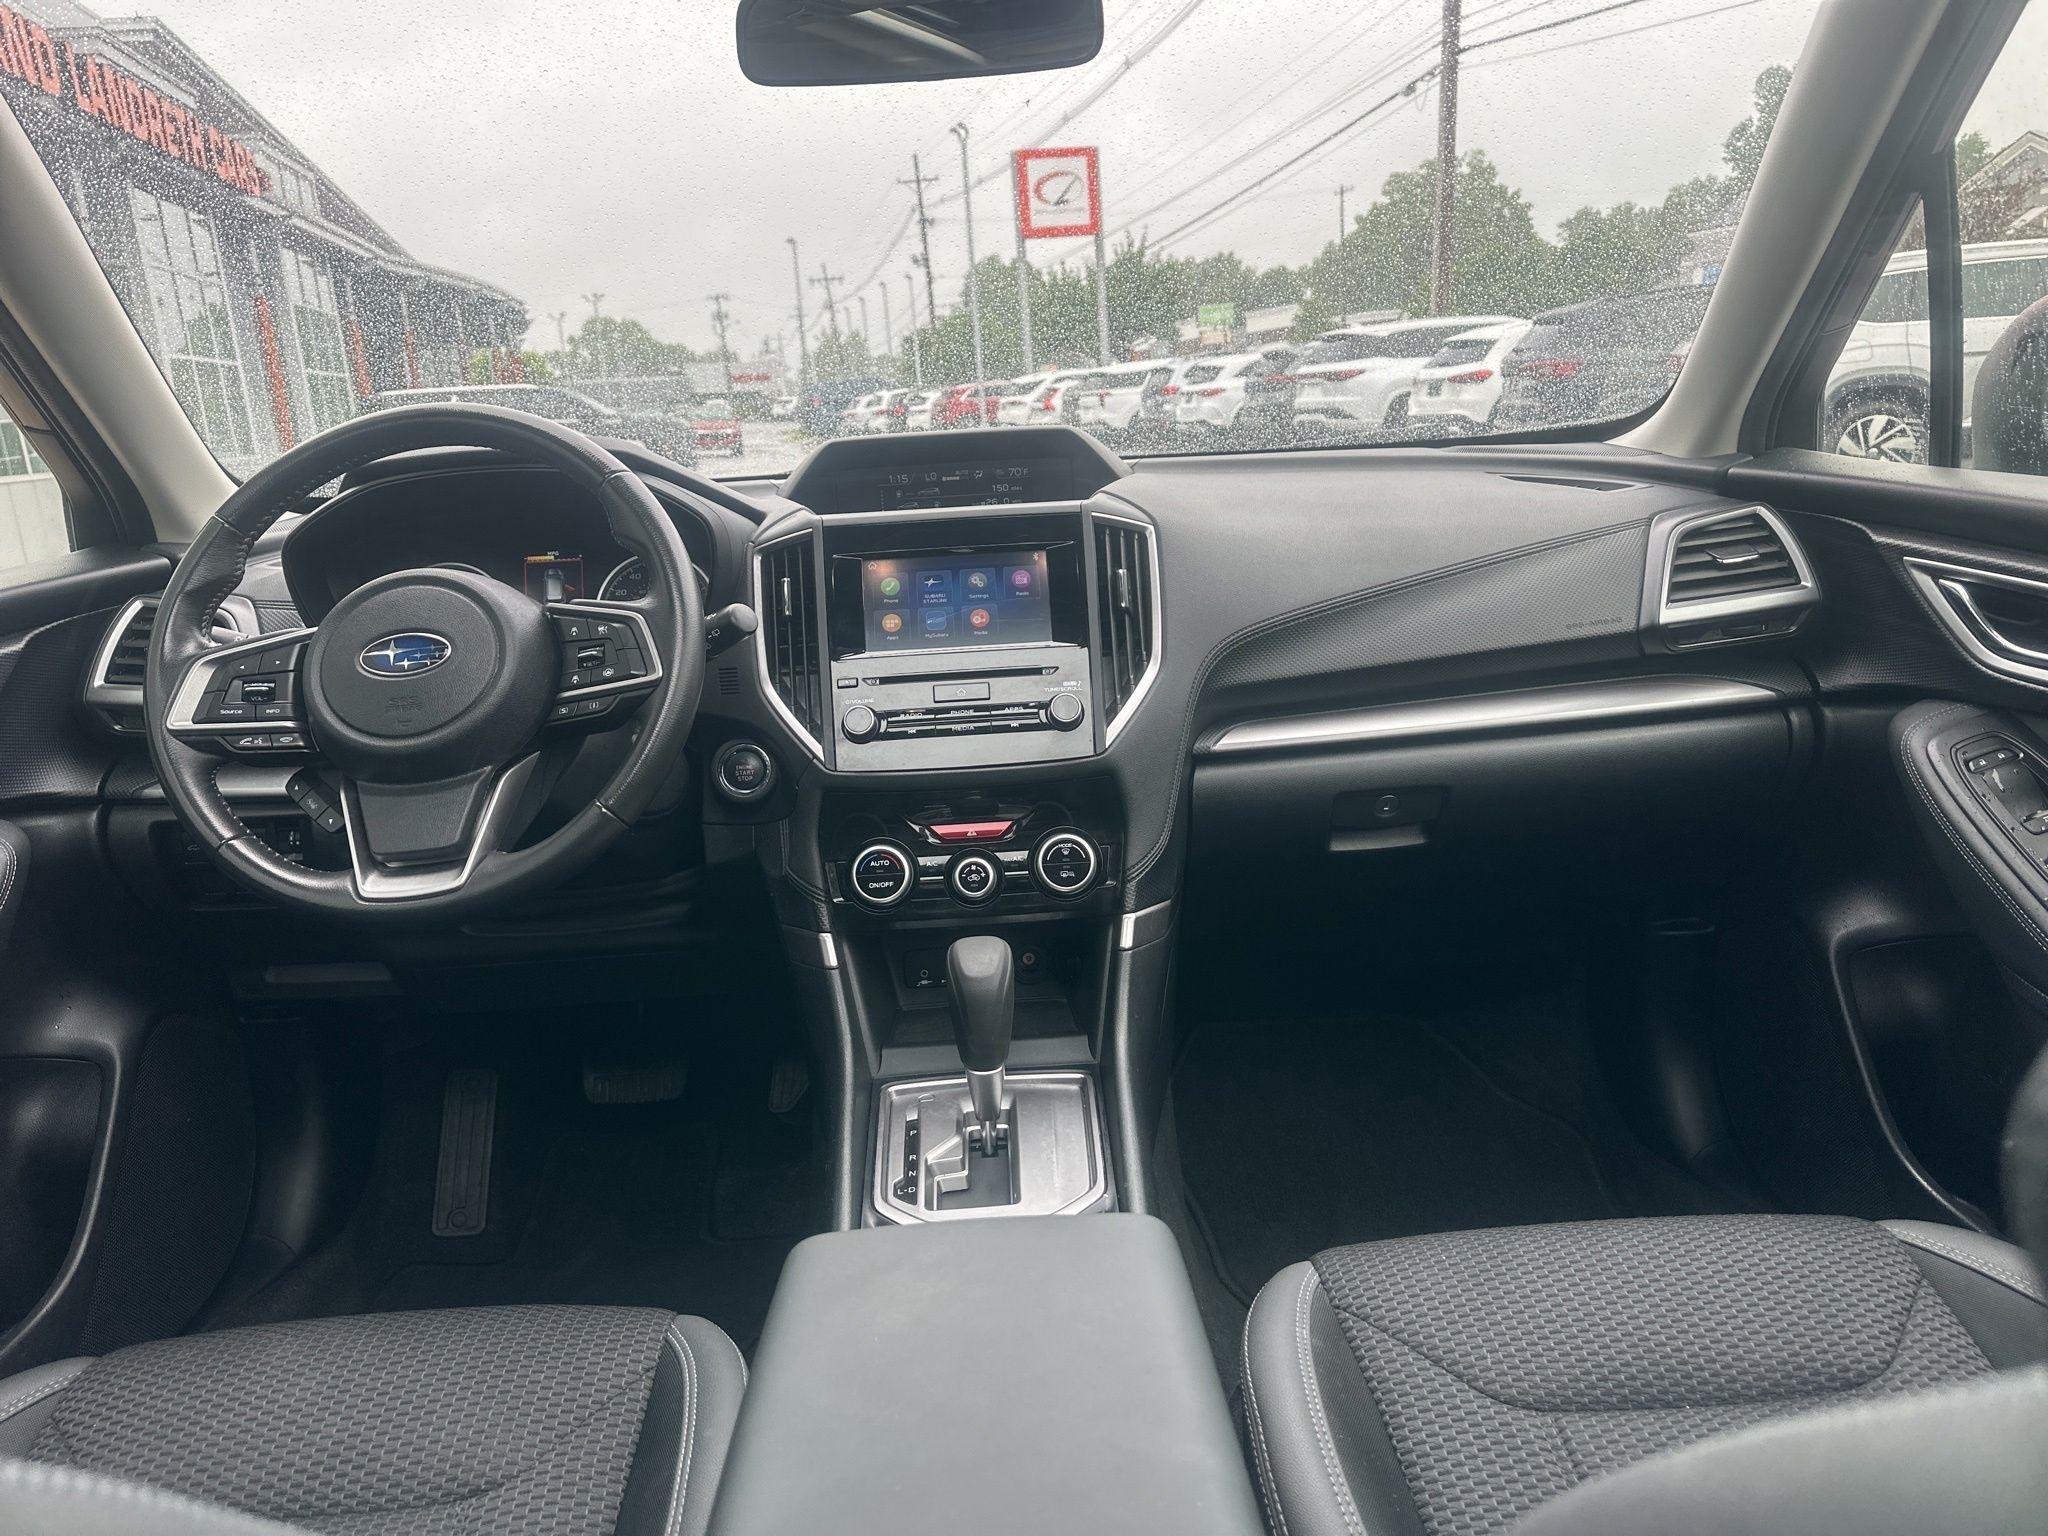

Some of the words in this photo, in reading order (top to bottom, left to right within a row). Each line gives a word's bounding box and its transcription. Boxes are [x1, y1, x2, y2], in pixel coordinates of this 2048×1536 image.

[0, 4, 62, 97] ND
[65, 40, 208, 172] LANDRETH
[889, 473, 908, 484] 1:15
[925, 472, 937, 481] LO
[992, 484, 1009, 492] 150
[868, 881, 894, 889] ON/OFF
